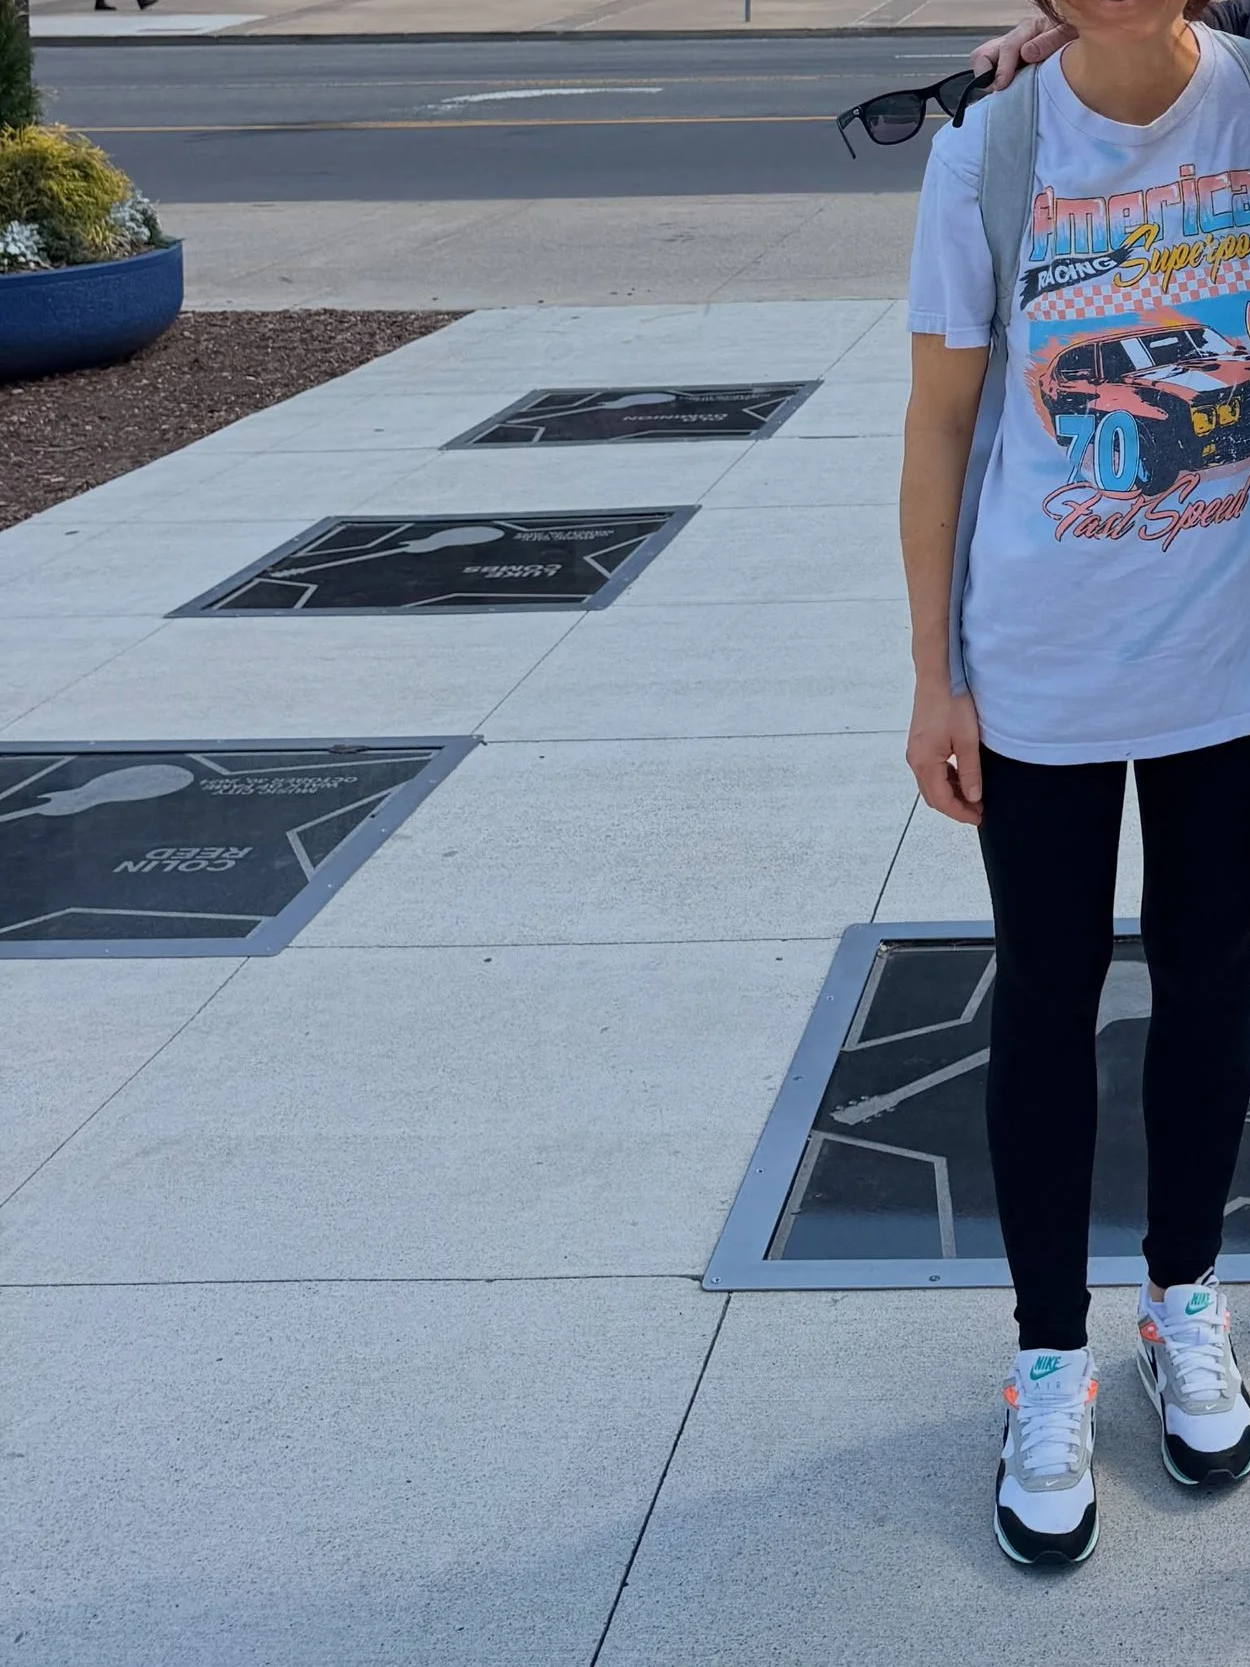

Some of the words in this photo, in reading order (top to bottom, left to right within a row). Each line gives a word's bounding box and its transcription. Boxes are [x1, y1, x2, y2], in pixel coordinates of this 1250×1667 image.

[1037, 255, 1118, 292] RACING
[1055, 410, 1140, 492] 70
[1042, 481, 1145, 543] Fast
[145, 846, 254, 860] REED
[112, 859, 236, 873] COLIN
[1190, 1291, 1211, 1306] NIKE
[1034, 1355, 1062, 1371] NIKE
